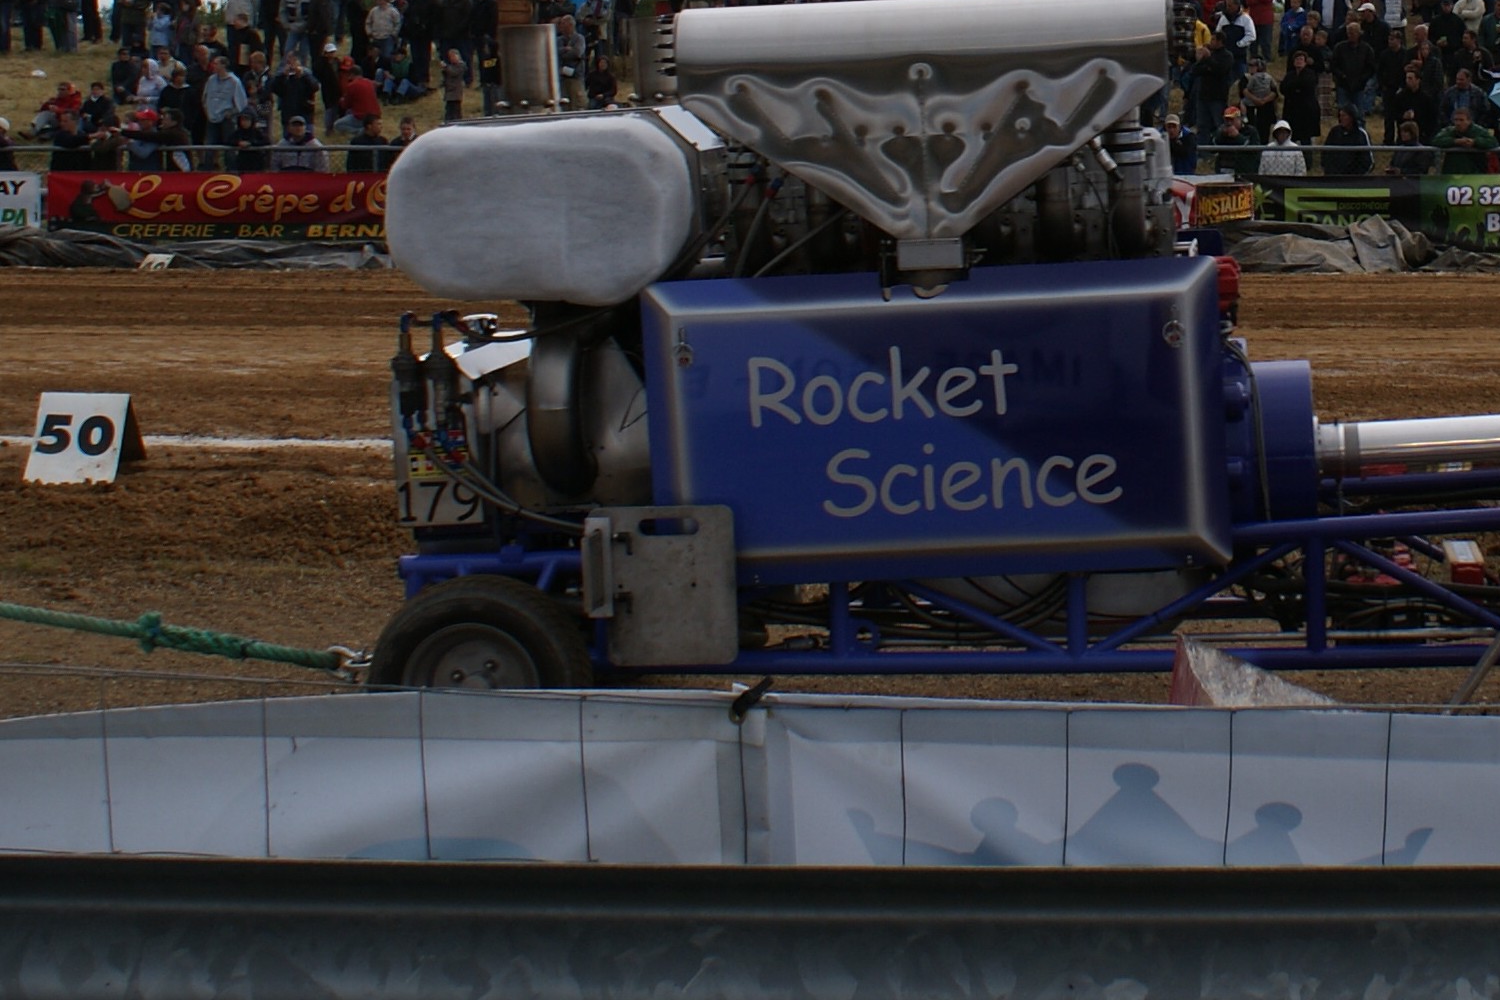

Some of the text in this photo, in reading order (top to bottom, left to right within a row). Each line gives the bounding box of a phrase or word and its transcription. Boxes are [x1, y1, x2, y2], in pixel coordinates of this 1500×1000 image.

[127, 174, 186, 219] La
[197, 174, 321, 222] Crêpe
[1447, 186, 1473, 205] 02
[112, 223, 216, 238] CREPERIE
[237, 224, 285, 238] BAR
[748, 345, 1018, 427] Rocket
[34, 414, 116, 456] 50
[823, 443, 1123, 517] Science
[399, 481, 480, 523] 179
